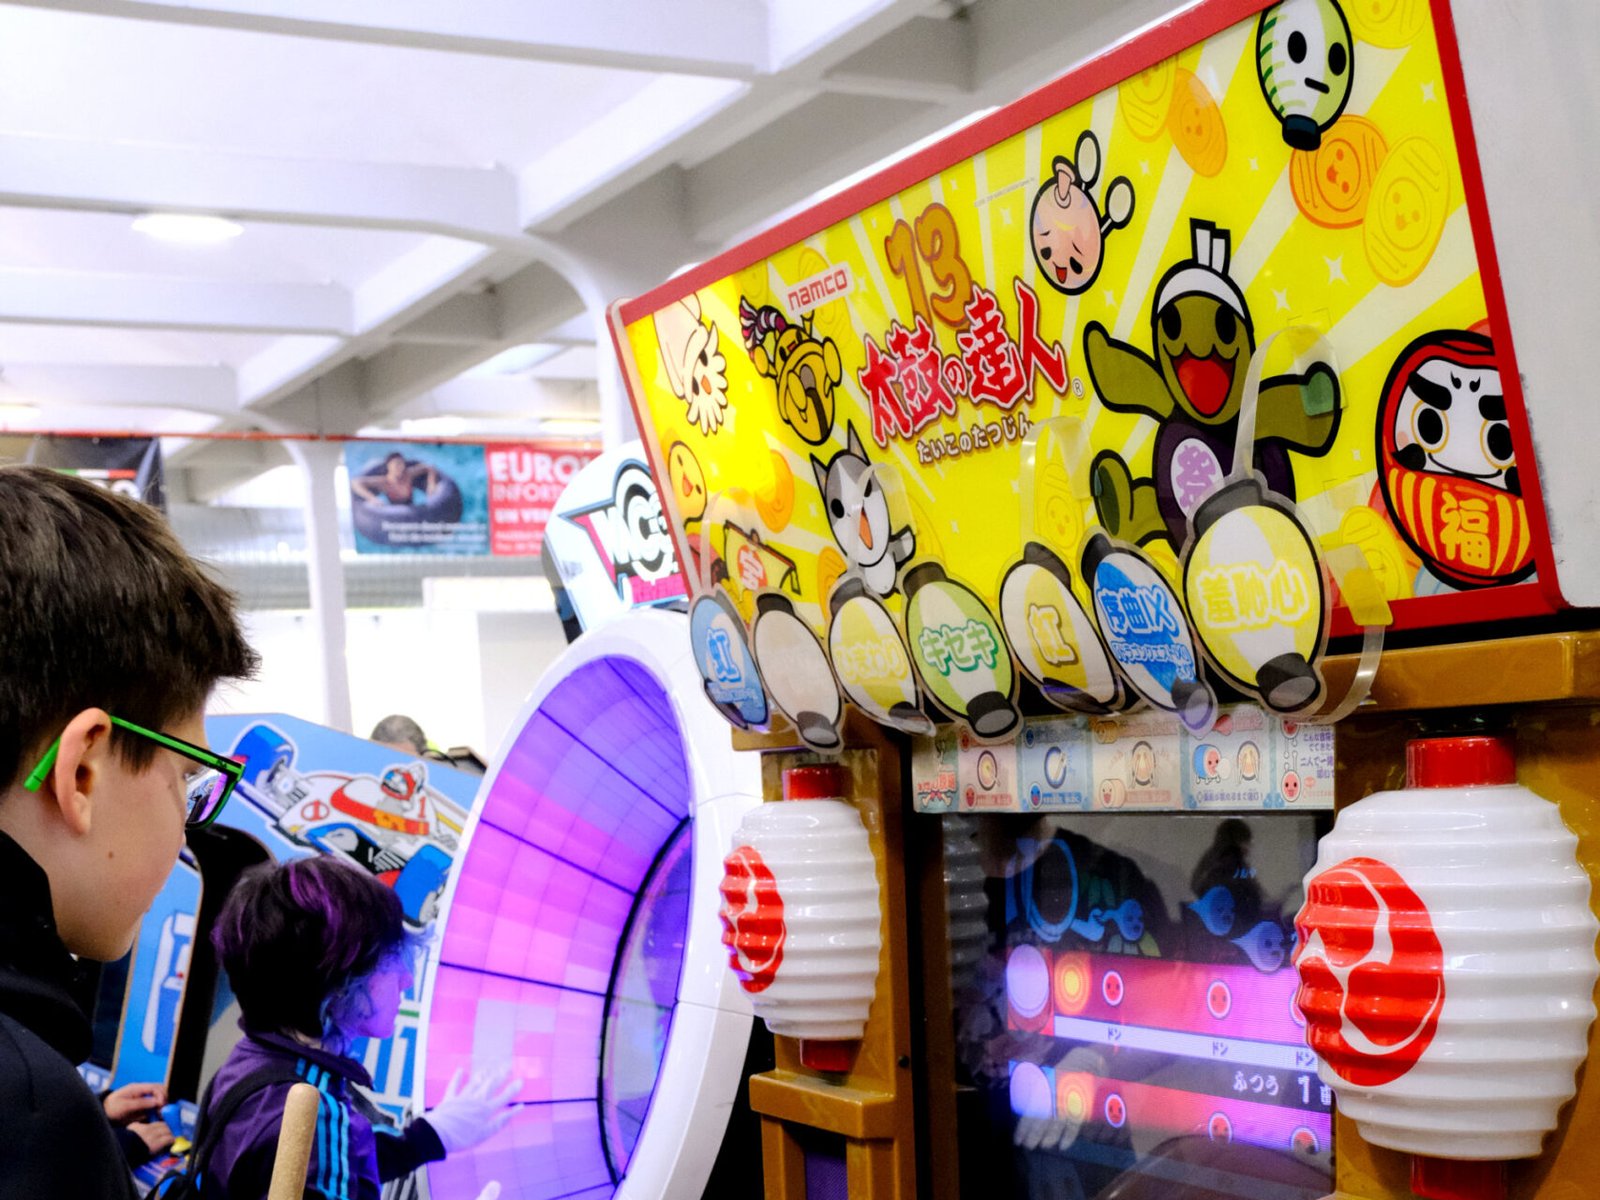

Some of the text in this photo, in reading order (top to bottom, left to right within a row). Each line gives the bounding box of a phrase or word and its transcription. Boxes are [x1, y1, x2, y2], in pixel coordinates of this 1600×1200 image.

[787, 269, 848, 311] namco
[885, 203, 971, 335] 13
[860, 278, 1067, 447] 太鼓の達人
[917, 414, 1032, 464] たいこのたつじん
[1440, 483, 1495, 569] 福
[707, 628, 742, 682] 虹
[919, 619, 998, 676] キセキ
[1233, 1070, 1279, 1096] ふつう
